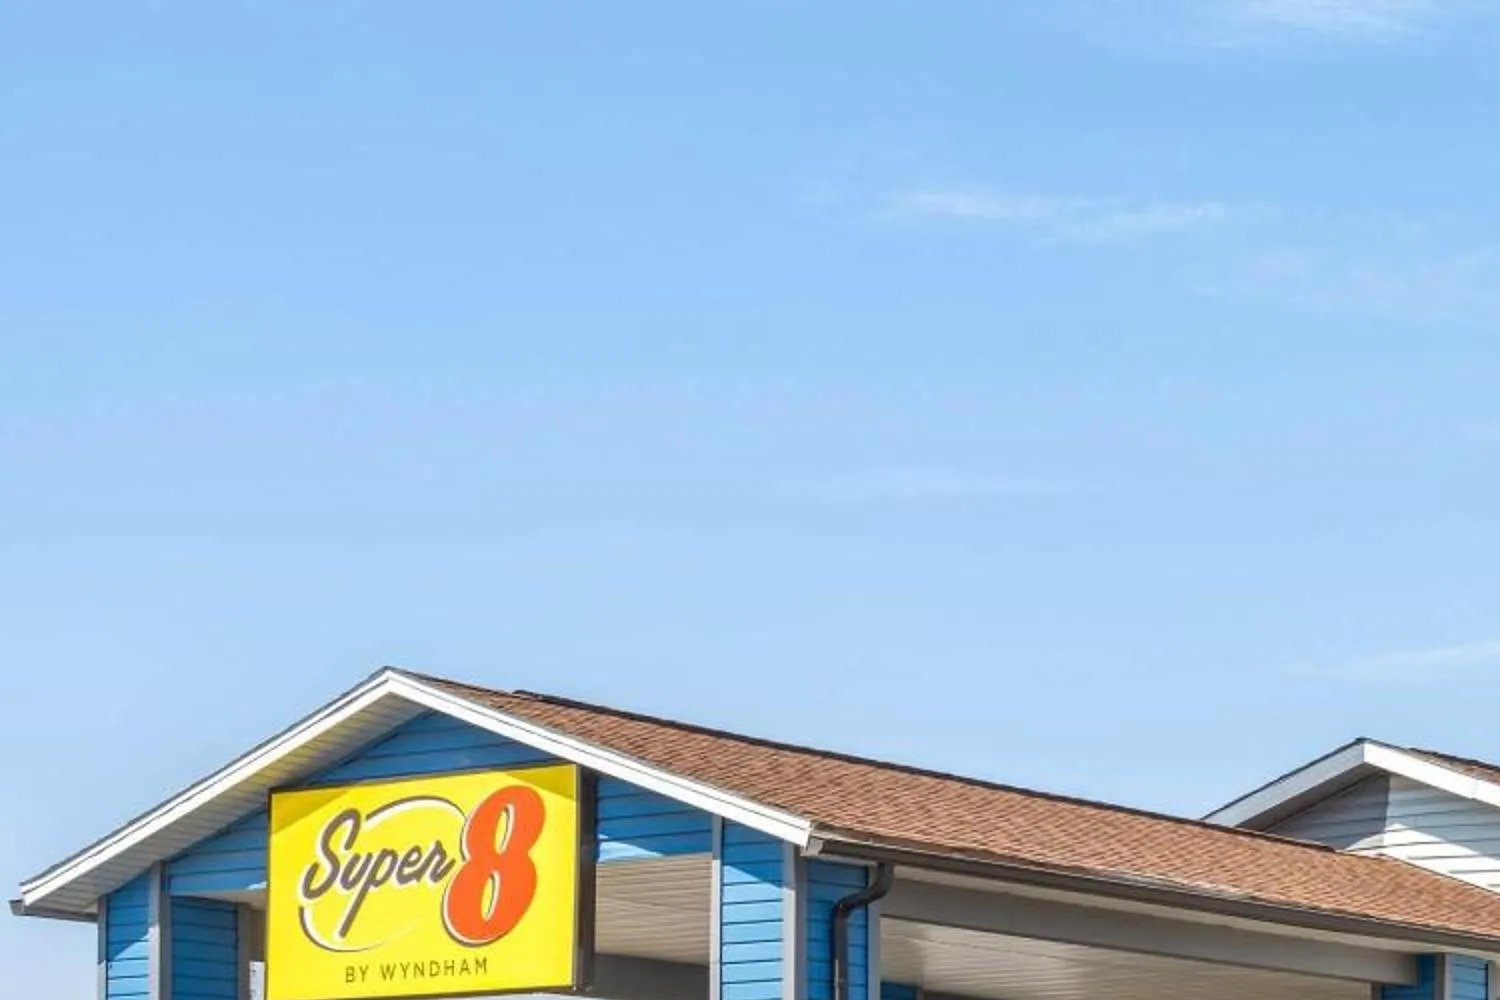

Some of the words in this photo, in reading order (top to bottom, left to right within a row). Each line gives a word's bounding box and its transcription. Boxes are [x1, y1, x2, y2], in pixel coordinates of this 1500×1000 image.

[302, 807, 455, 939] Super
[443, 784, 547, 947] 8
[345, 965, 369, 983] BY
[380, 956, 488, 981] WYNDHAM
